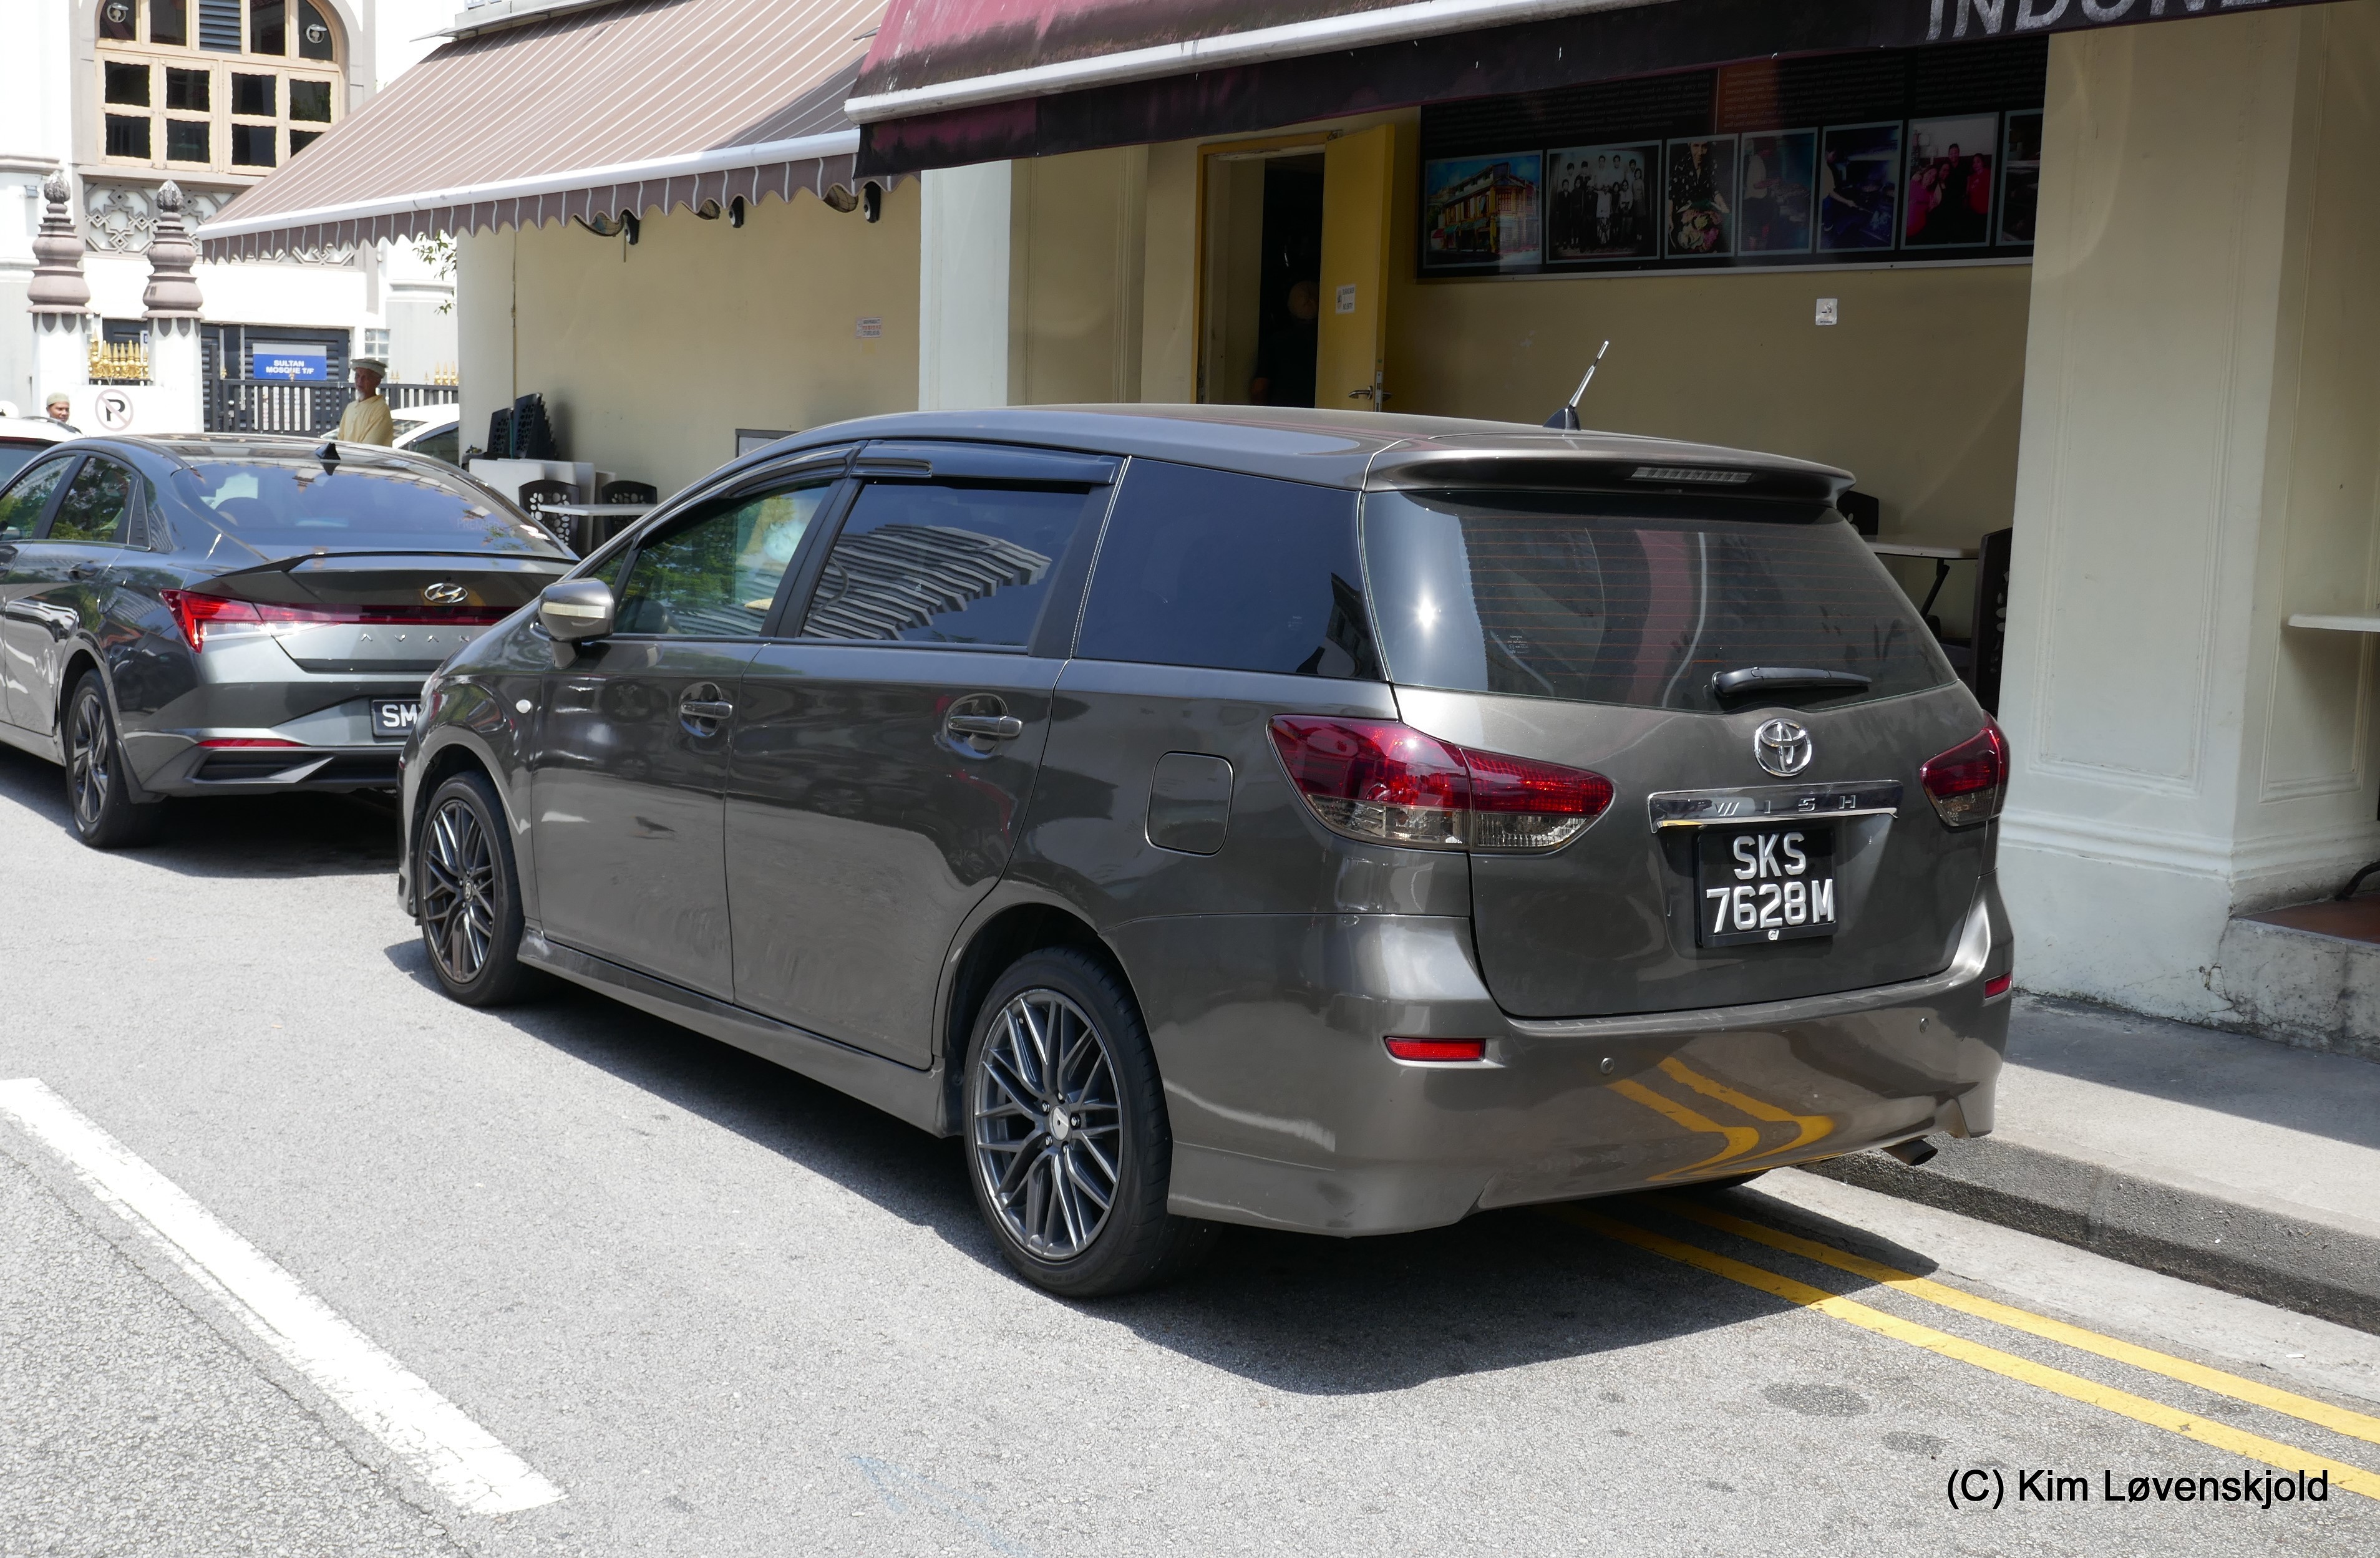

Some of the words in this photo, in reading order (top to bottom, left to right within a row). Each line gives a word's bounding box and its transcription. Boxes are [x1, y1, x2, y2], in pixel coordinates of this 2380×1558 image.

[1926, 0, 2270, 41] IND
[266, 366, 301, 374] MOSQUE
[382, 704, 423, 728] SM
[1715, 795, 1856, 816] WISH
[1732, 831, 1806, 880] SKS
[1706, 878, 1835, 934] 7628M
